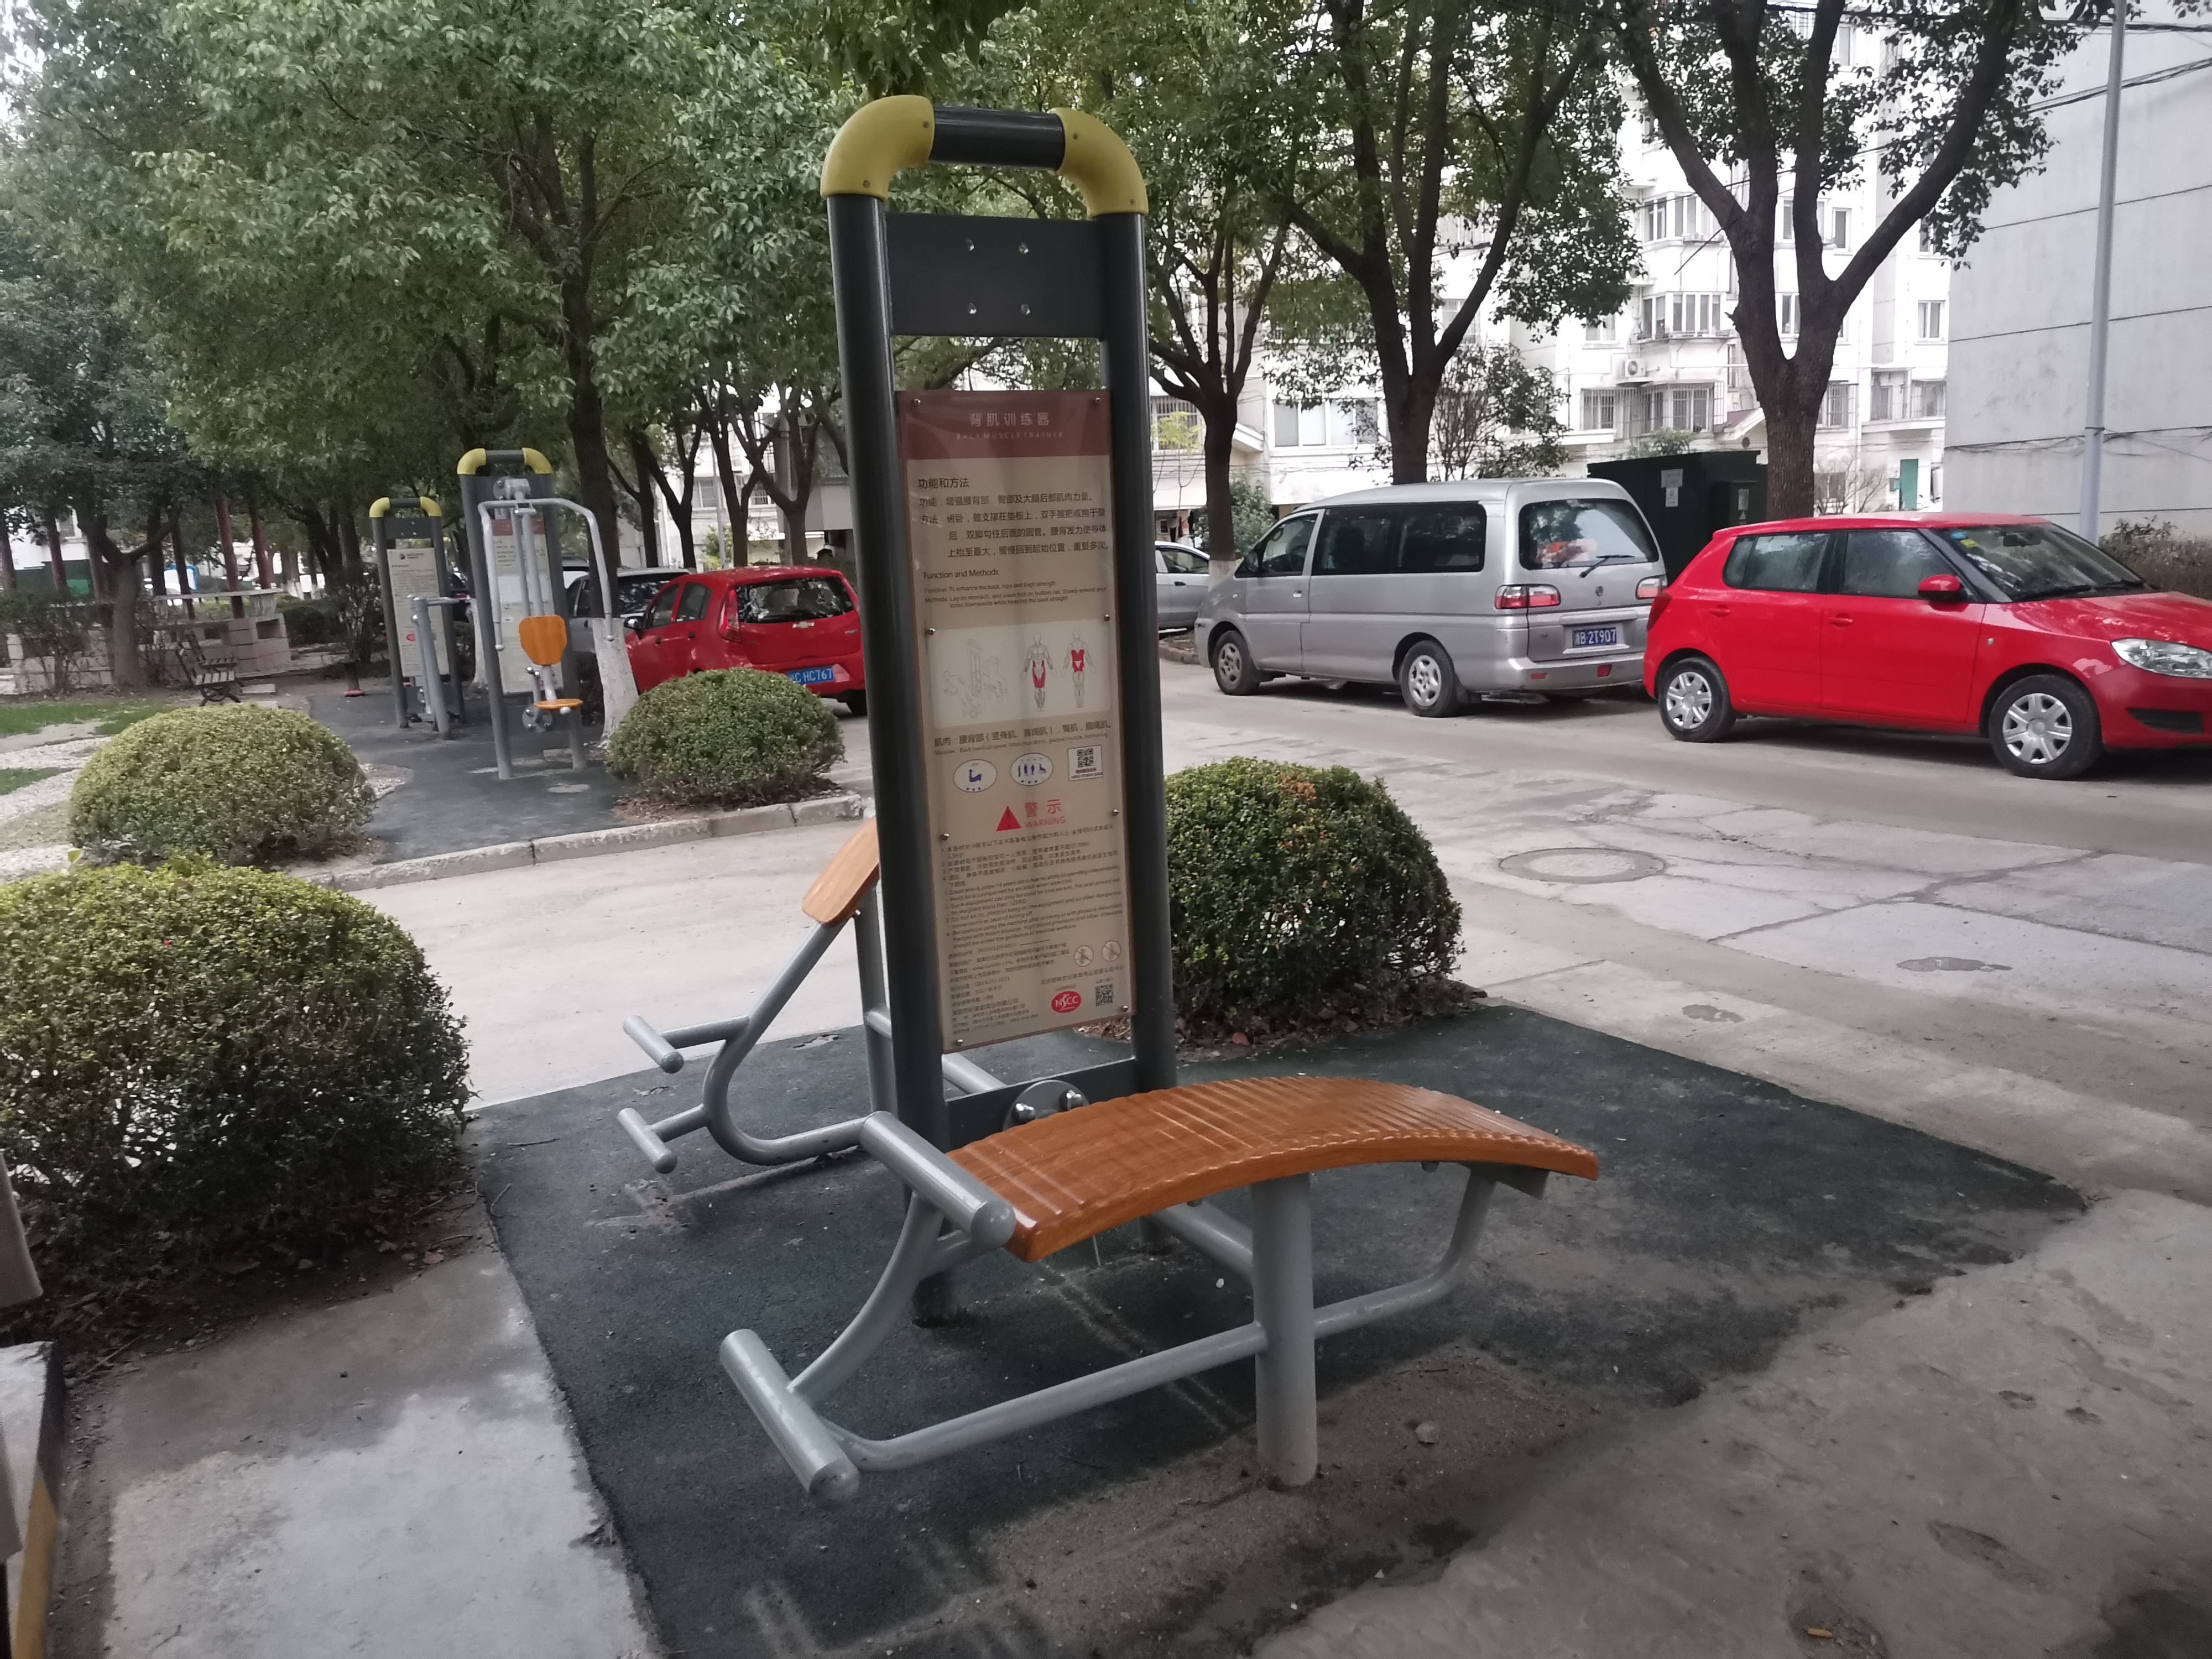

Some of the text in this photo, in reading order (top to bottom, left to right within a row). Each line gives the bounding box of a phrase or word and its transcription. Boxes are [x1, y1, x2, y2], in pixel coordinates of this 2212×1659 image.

[968, 412, 1050, 428] 背肌训练器
[984, 431, 1021, 440] MUSCLE
[917, 477, 969, 489] 功能和方法
[924, 571, 953, 580] Function
[969, 568, 999, 577] Methods
[791, 668, 832, 682] C·HC767
[1024, 799, 1062, 818] 警示
[1025, 816, 1066, 828] WARNING
[1055, 993, 1079, 1009] NSCC
